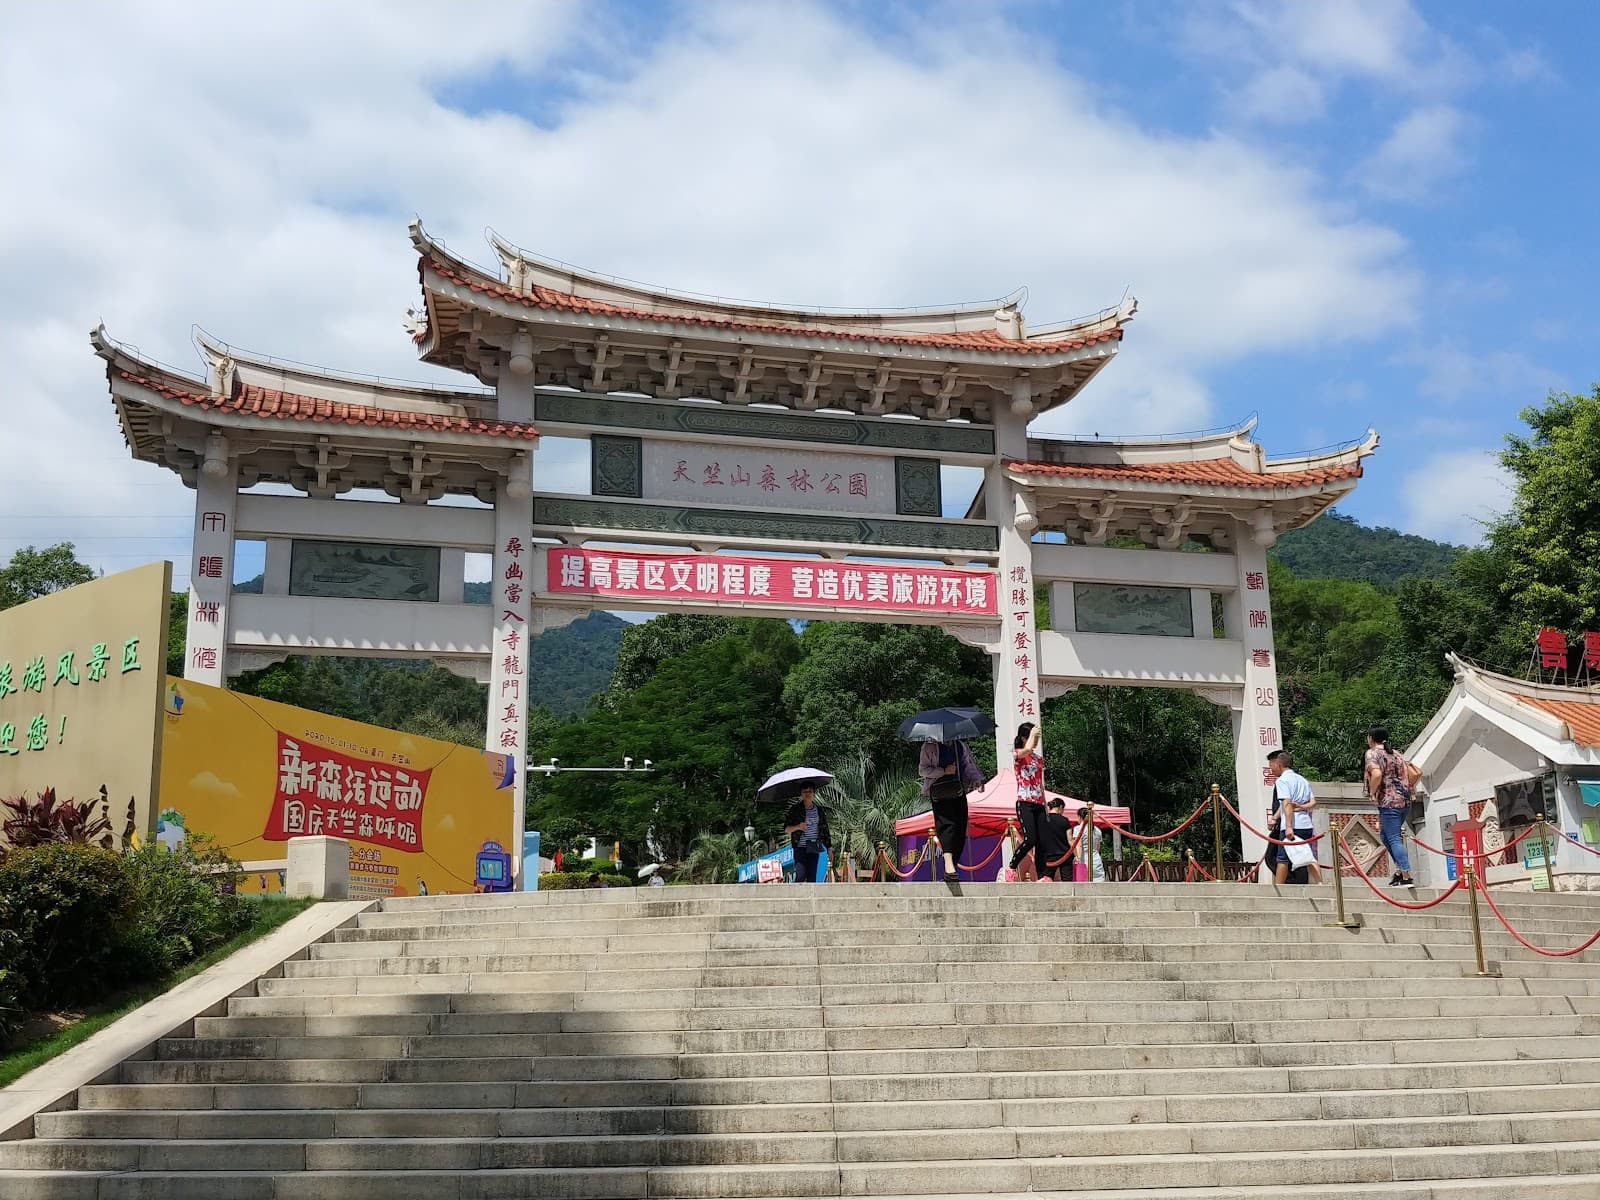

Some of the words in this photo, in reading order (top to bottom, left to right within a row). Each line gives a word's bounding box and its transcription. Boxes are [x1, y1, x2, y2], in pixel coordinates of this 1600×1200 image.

[560, 554, 772, 597] 提高景区文明程度
[791, 567, 988, 608] 营造优美旅游环境
[280, 739, 422, 811] 新森活运动
[283, 799, 417, 845] 国庆天竺森呼吸
